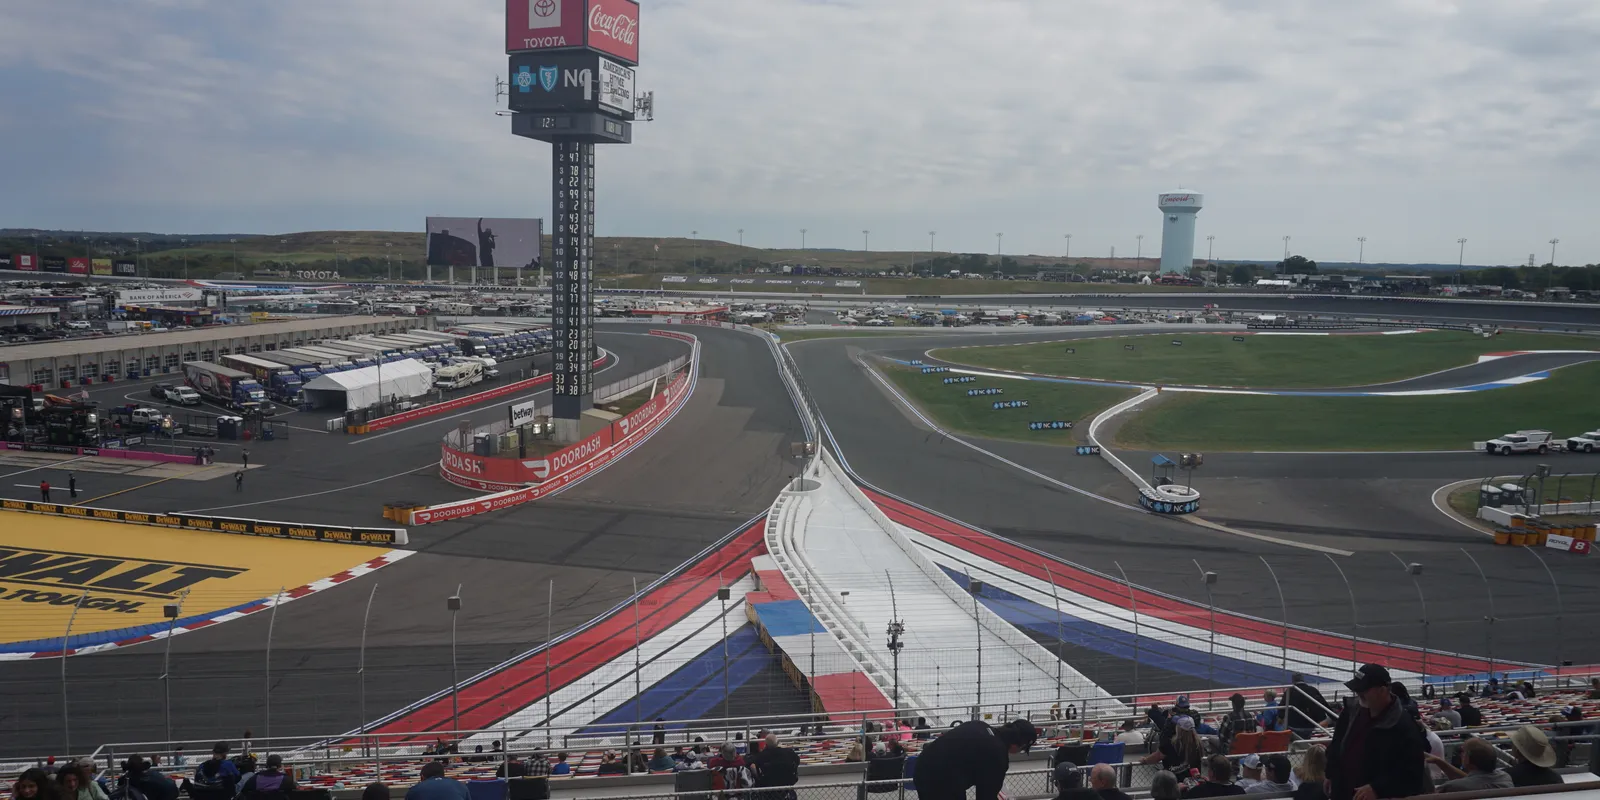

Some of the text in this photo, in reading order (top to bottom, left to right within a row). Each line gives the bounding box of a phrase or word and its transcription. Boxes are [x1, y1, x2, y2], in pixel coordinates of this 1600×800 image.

[588, 4, 638, 45] Coca-Cola
[524, 36, 566, 48] TOYOTA
[603, 60, 630, 80] AMERICA'S
[610, 73, 624, 88] HME
[569, 153, 578, 162] 47
[570, 166, 578, 175] 78
[569, 177, 578, 186] 22
[570, 190, 578, 199] 99
[569, 213, 578, 223] 43
[569, 224, 578, 234] 42
[571, 237, 578, 246] 14
[296, 270, 340, 279] TOYOTA
[569, 271, 578, 280] 48
[571, 283, 578, 293] 12
[570, 294, 578, 303] 77
[571, 307, 578, 315] 11
[569, 317, 578, 326] 41
[569, 329, 578, 339] 23
[569, 340, 578, 349] 20
[569, 352, 578, 361] 21
[570, 363, 578, 372] 34
[556, 374, 564, 384] 33
[556, 385, 578, 395] 34 38
[513, 407, 534, 420] betway
[630, 401, 657, 428] DOORDASH
[553, 436, 600, 471] DOORDASH
[540, 480, 561, 493] DOORDASH
[493, 493, 527, 506] DOORDASH
[433, 506, 475, 518] DOORDASH
[1575, 542, 1585, 550] 8
[1, 589, 145, 614] TOUGH.
